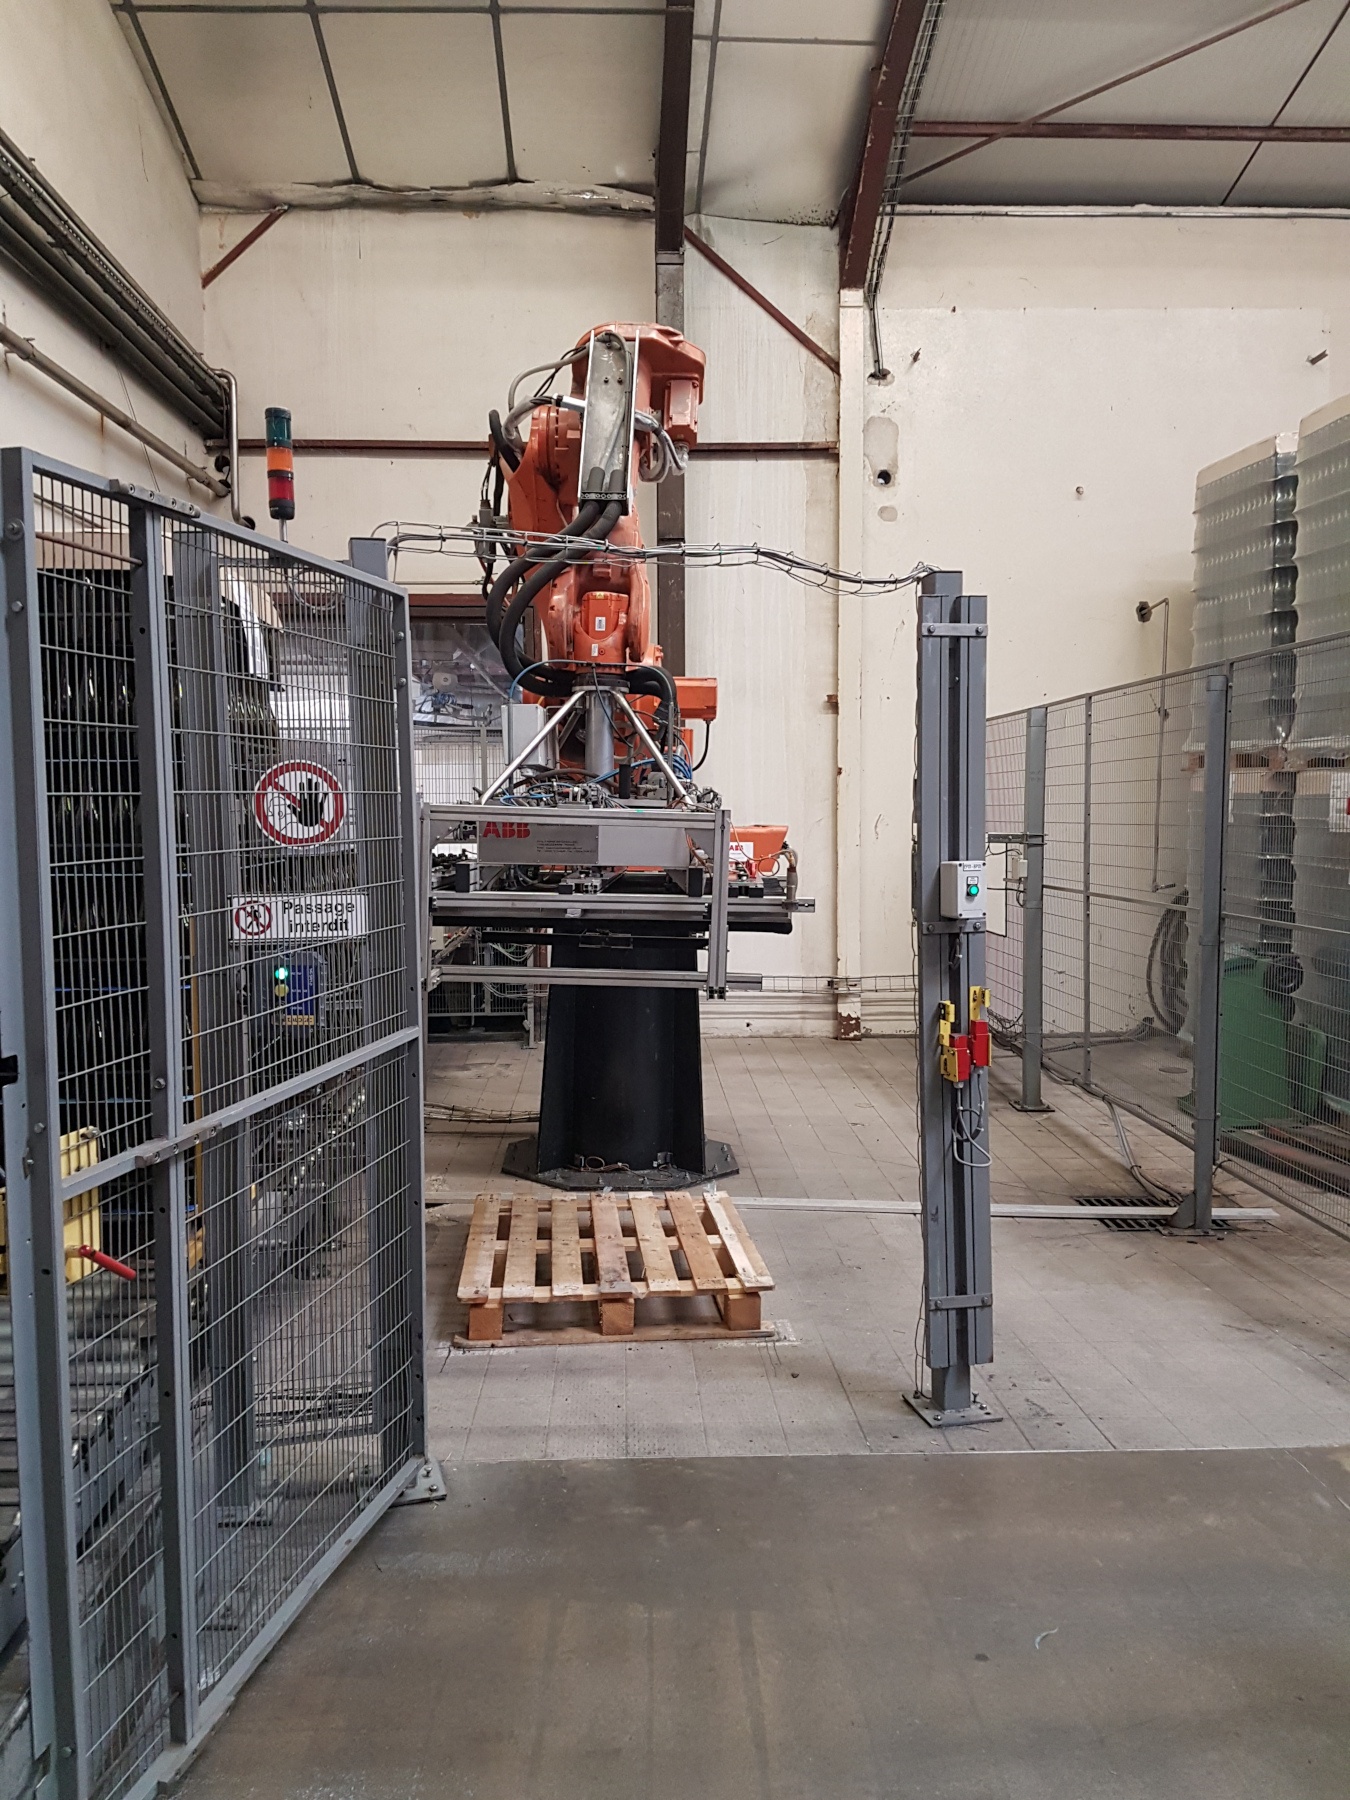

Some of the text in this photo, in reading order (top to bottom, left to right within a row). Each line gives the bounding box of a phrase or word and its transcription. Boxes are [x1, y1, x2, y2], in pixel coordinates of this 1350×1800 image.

[482, 822, 531, 839] ABB
[283, 901, 355, 916] Passage
[289, 918, 349, 933] interdit
